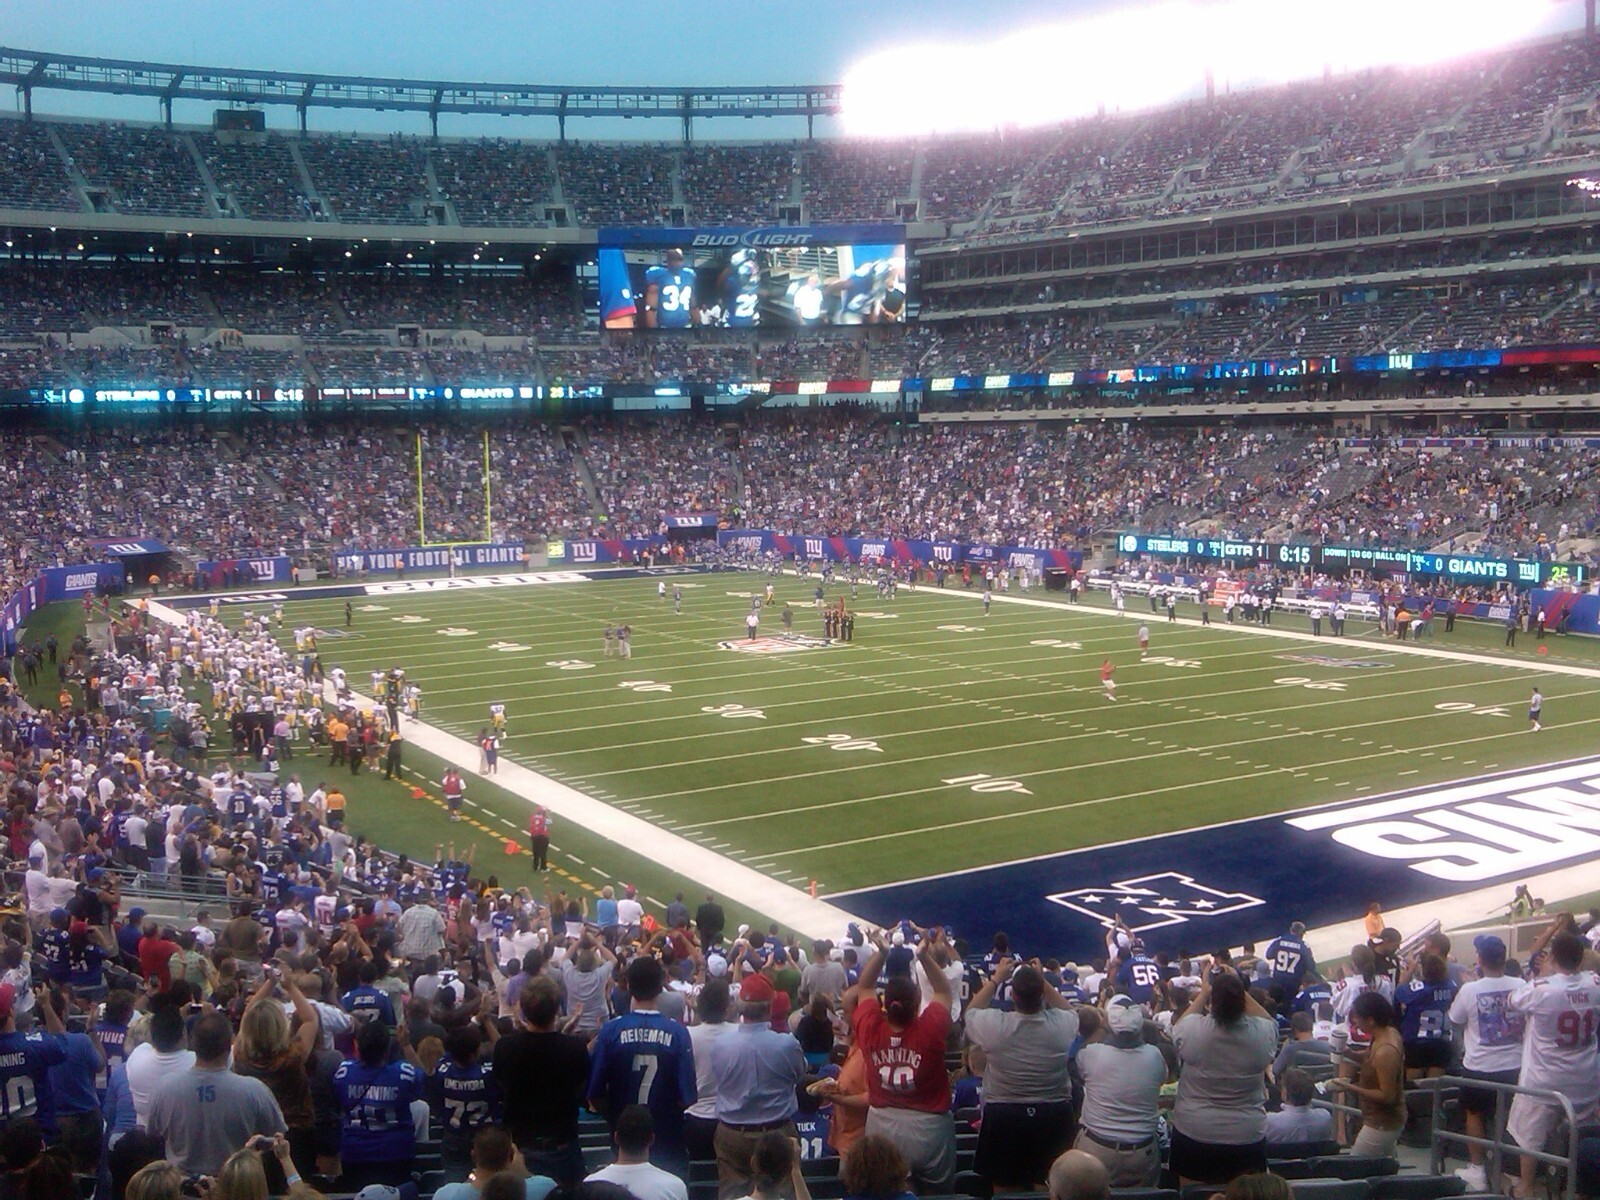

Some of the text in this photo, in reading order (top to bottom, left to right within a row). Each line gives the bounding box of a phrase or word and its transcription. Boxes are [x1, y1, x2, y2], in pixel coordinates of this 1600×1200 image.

[692, 233, 813, 246] BUD LIGHT
[662, 285, 691, 311] 34
[166, 389, 176, 401] 0
[245, 390, 252, 400] 1
[274, 389, 304, 402] 6:15
[460, 387, 514, 399] GIANTS
[862, 543, 885, 556] GIANTS
[1147, 539, 1204, 554] STEELERS 0
[1257, 545, 1262, 557] 1
[1324, 548, 1347, 557] DOWN
[1351, 550, 1372, 559] TO GO
[476, 547, 524, 563] GIANTS
[1279, 546, 1310, 564] 6:15
[1375, 552, 1406, 562] BALL ON
[1435, 559, 1507, 577] 0 GIANTS
[65, 572, 98, 588] GIANTS
[801, 733, 876, 751] 20
[941, 773, 1025, 793] 10
[1277, 950, 1301, 974] 97
[1132, 964, 1160, 986] 56
[1567, 992, 1589, 1004] TUCK
[1555, 1008, 1593, 1047] 91
[620, 1029, 673, 1048] REISEMAN
[871, 1047, 922, 1069] MANNING
[632, 1054, 658, 1105] 7
[879, 1065, 914, 1089] 10
[196, 1085, 216, 1103] 15
[444, 1097, 493, 1129] 72
[796, 1121, 816, 1132] TUCK
